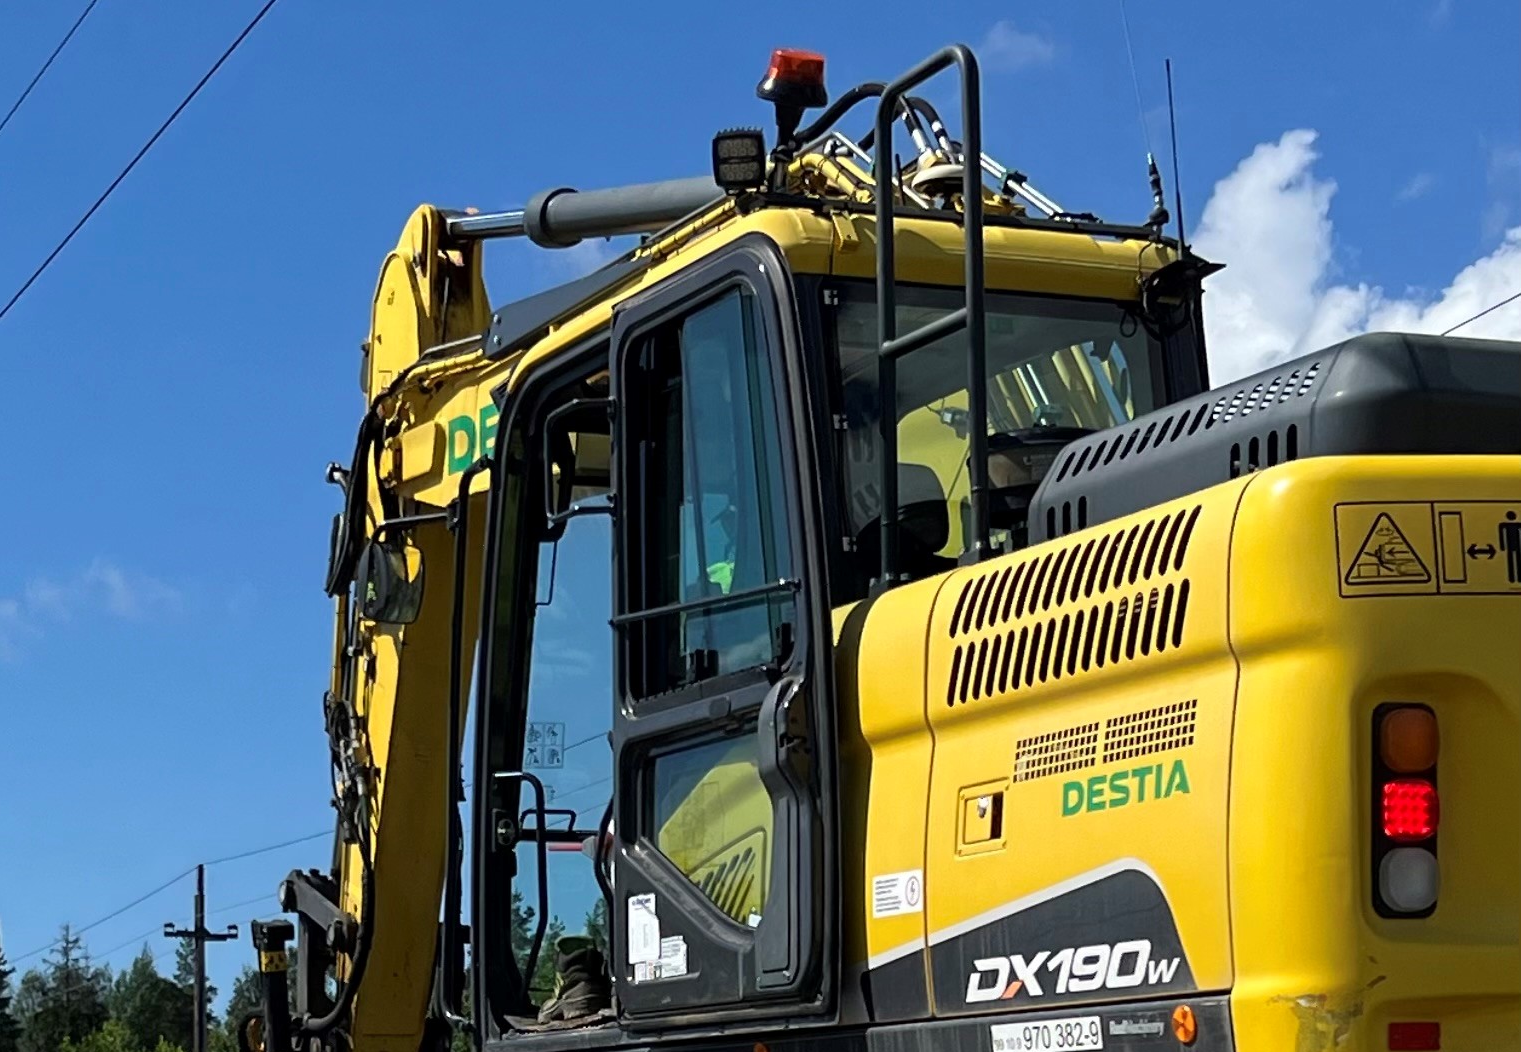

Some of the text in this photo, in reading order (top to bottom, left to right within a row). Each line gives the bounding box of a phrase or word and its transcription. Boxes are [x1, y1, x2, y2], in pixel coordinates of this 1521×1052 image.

[1062, 759, 1190, 816] DESTIA
[1023, 1024, 1052, 1051] 970
[1055, 1020, 1100, 1049] 382-9
